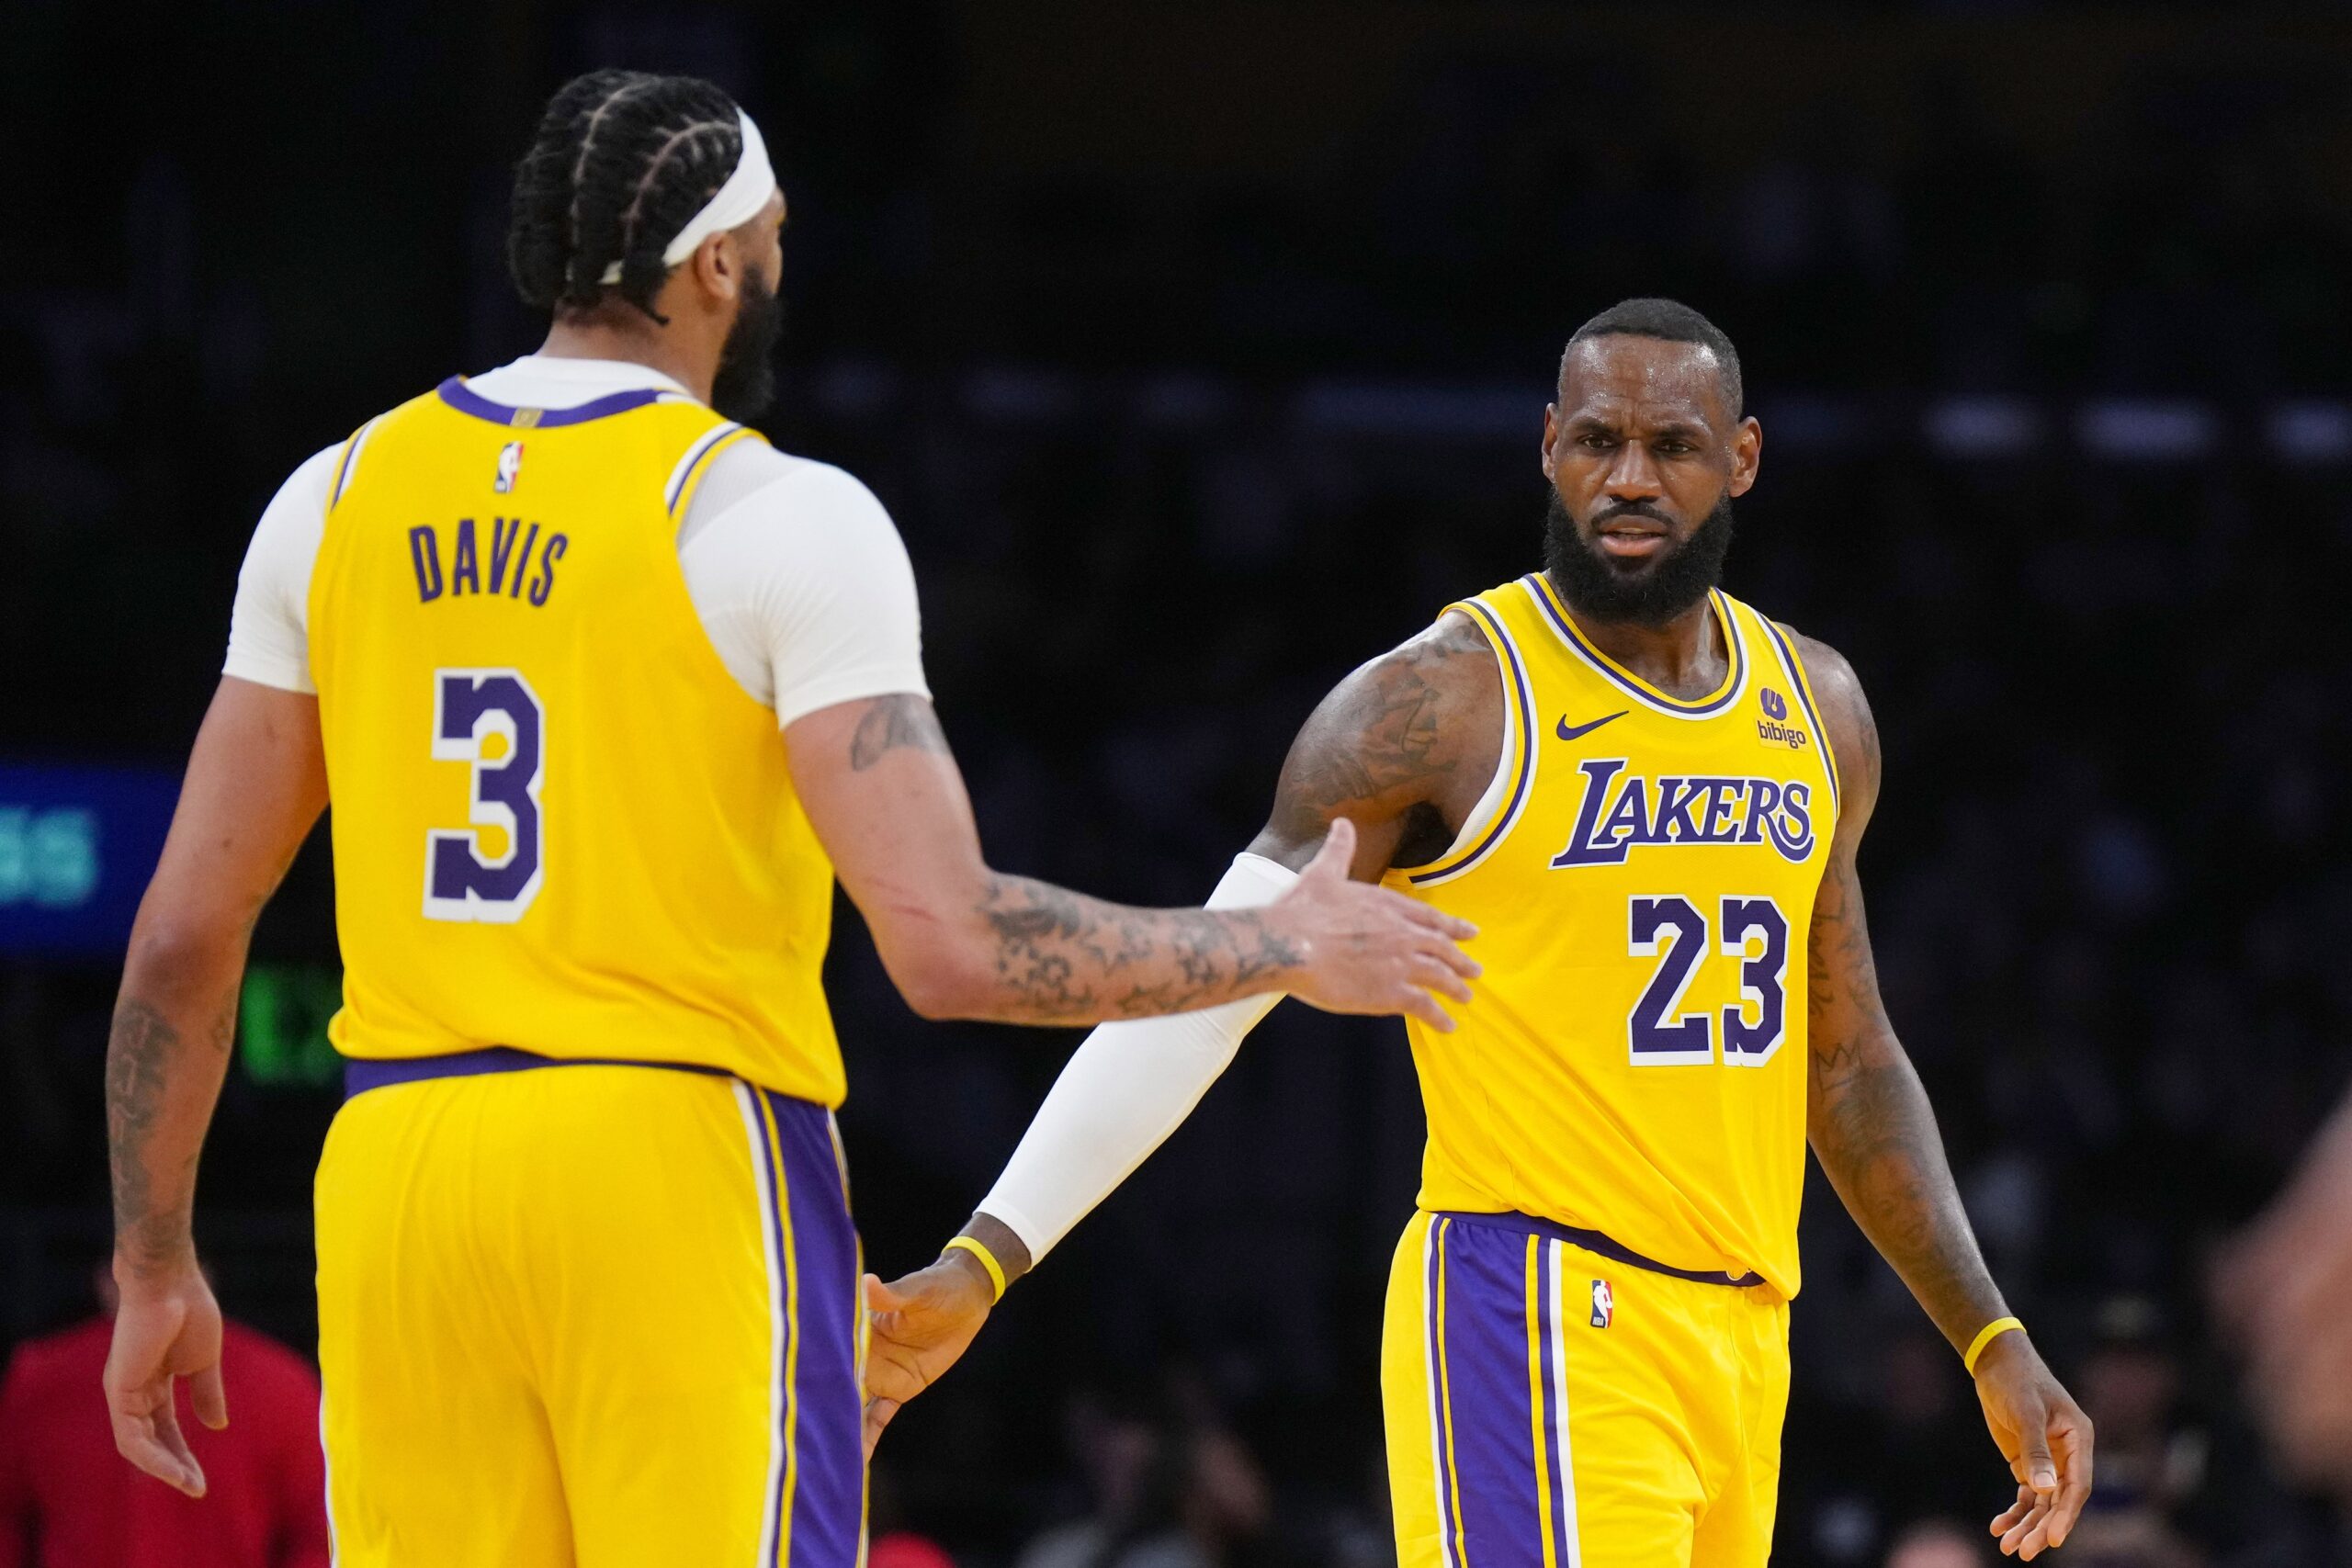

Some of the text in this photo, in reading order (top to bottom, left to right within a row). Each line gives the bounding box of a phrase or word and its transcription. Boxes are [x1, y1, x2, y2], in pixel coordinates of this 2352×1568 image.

[410, 517, 568, 607] DAVIS
[1757, 720, 1806, 749] bibigo
[422, 666, 547, 924] 3
[1548, 757, 1815, 870] LAKERS
[1628, 894, 1790, 1067] 23
